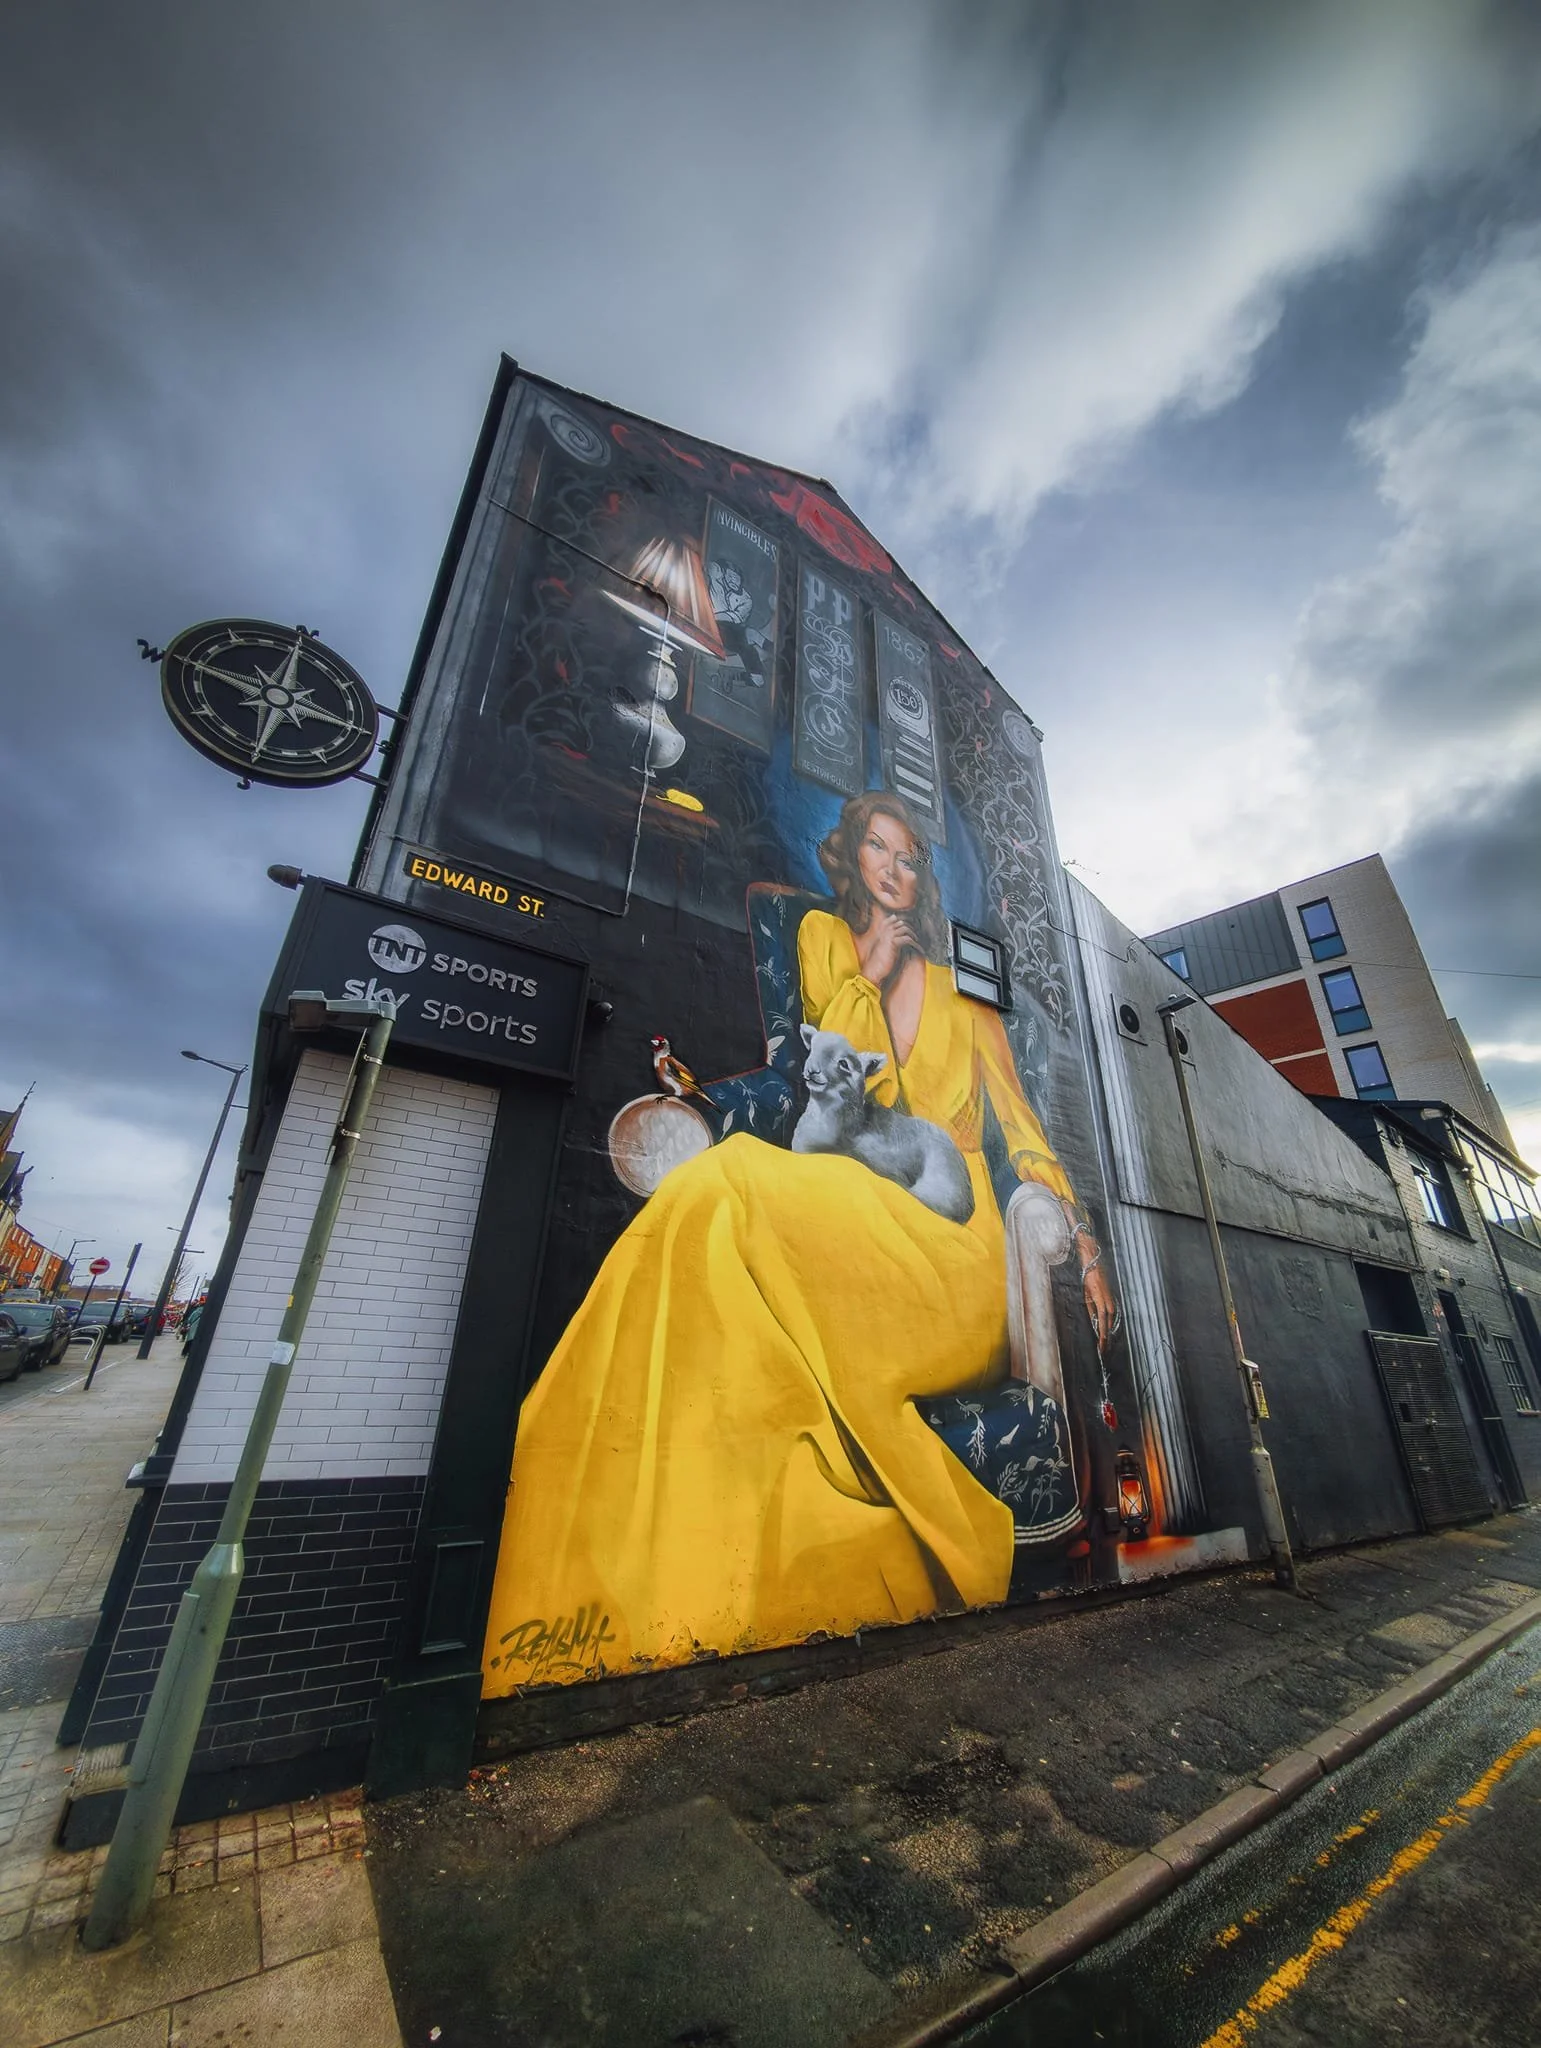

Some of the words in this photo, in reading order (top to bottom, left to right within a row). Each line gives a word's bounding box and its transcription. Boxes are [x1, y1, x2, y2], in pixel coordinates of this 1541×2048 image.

[713, 510, 777, 562] INVINCIBLES
[884, 626, 926, 664] 1867
[895, 688, 918, 709] 150
[411, 858, 509, 904] EDWARD
[518, 895, 545, 917] ST.
[371, 935, 427, 965] TNT
[430, 952, 539, 998] SPORTS
[342, 977, 411, 1010] sky
[420, 999, 538, 1045] sports
